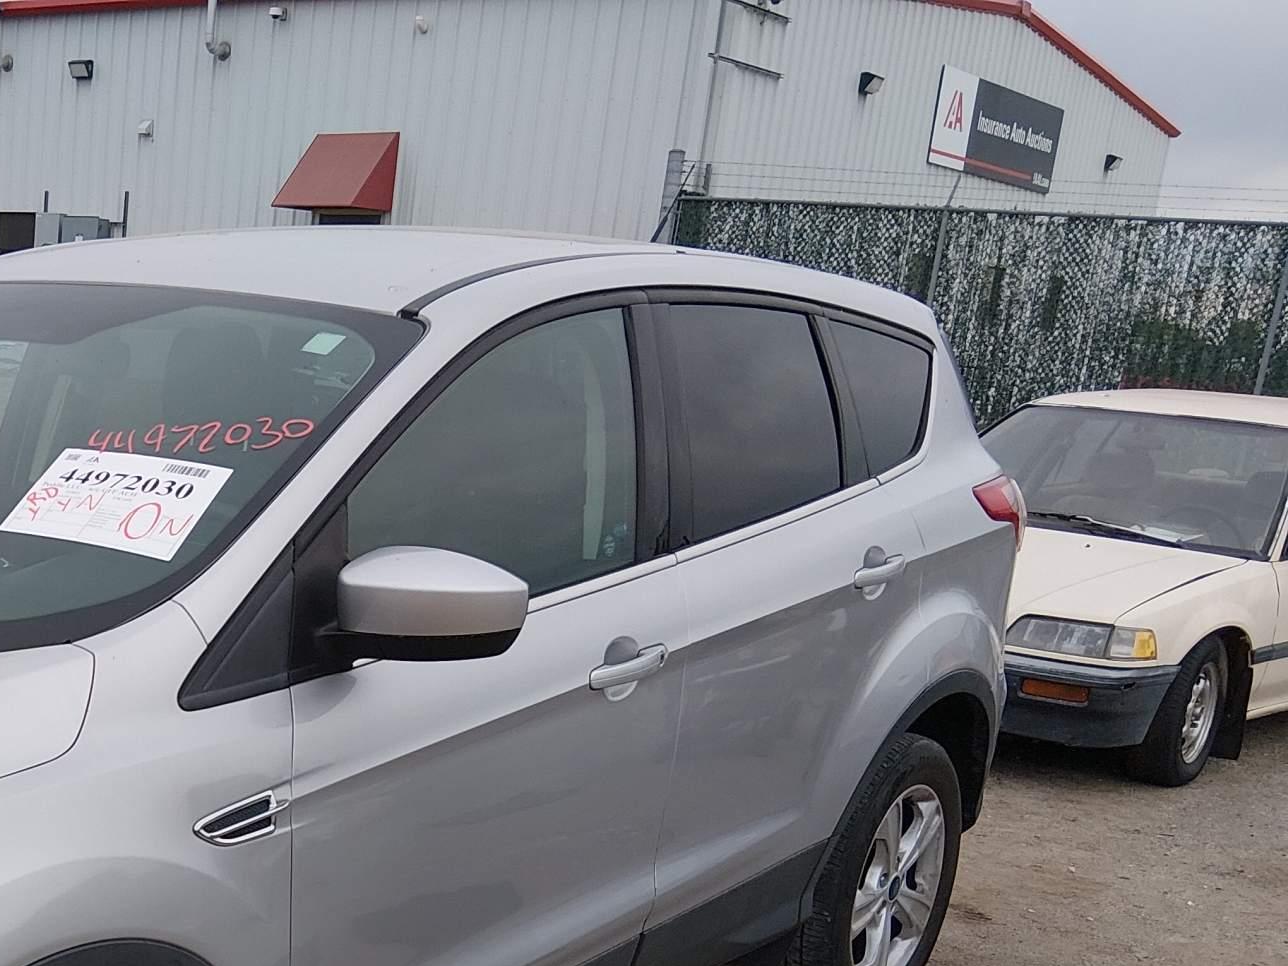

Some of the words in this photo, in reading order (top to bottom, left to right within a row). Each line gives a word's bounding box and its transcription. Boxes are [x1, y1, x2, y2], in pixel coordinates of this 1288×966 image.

[976, 110, 1011, 140] Insurance
[1010, 122, 1026, 145] Auto
[1025, 127, 1053, 154] Auctions
[88, 416, 314, 453] 44972030
[59, 468, 195, 500] 44972030
